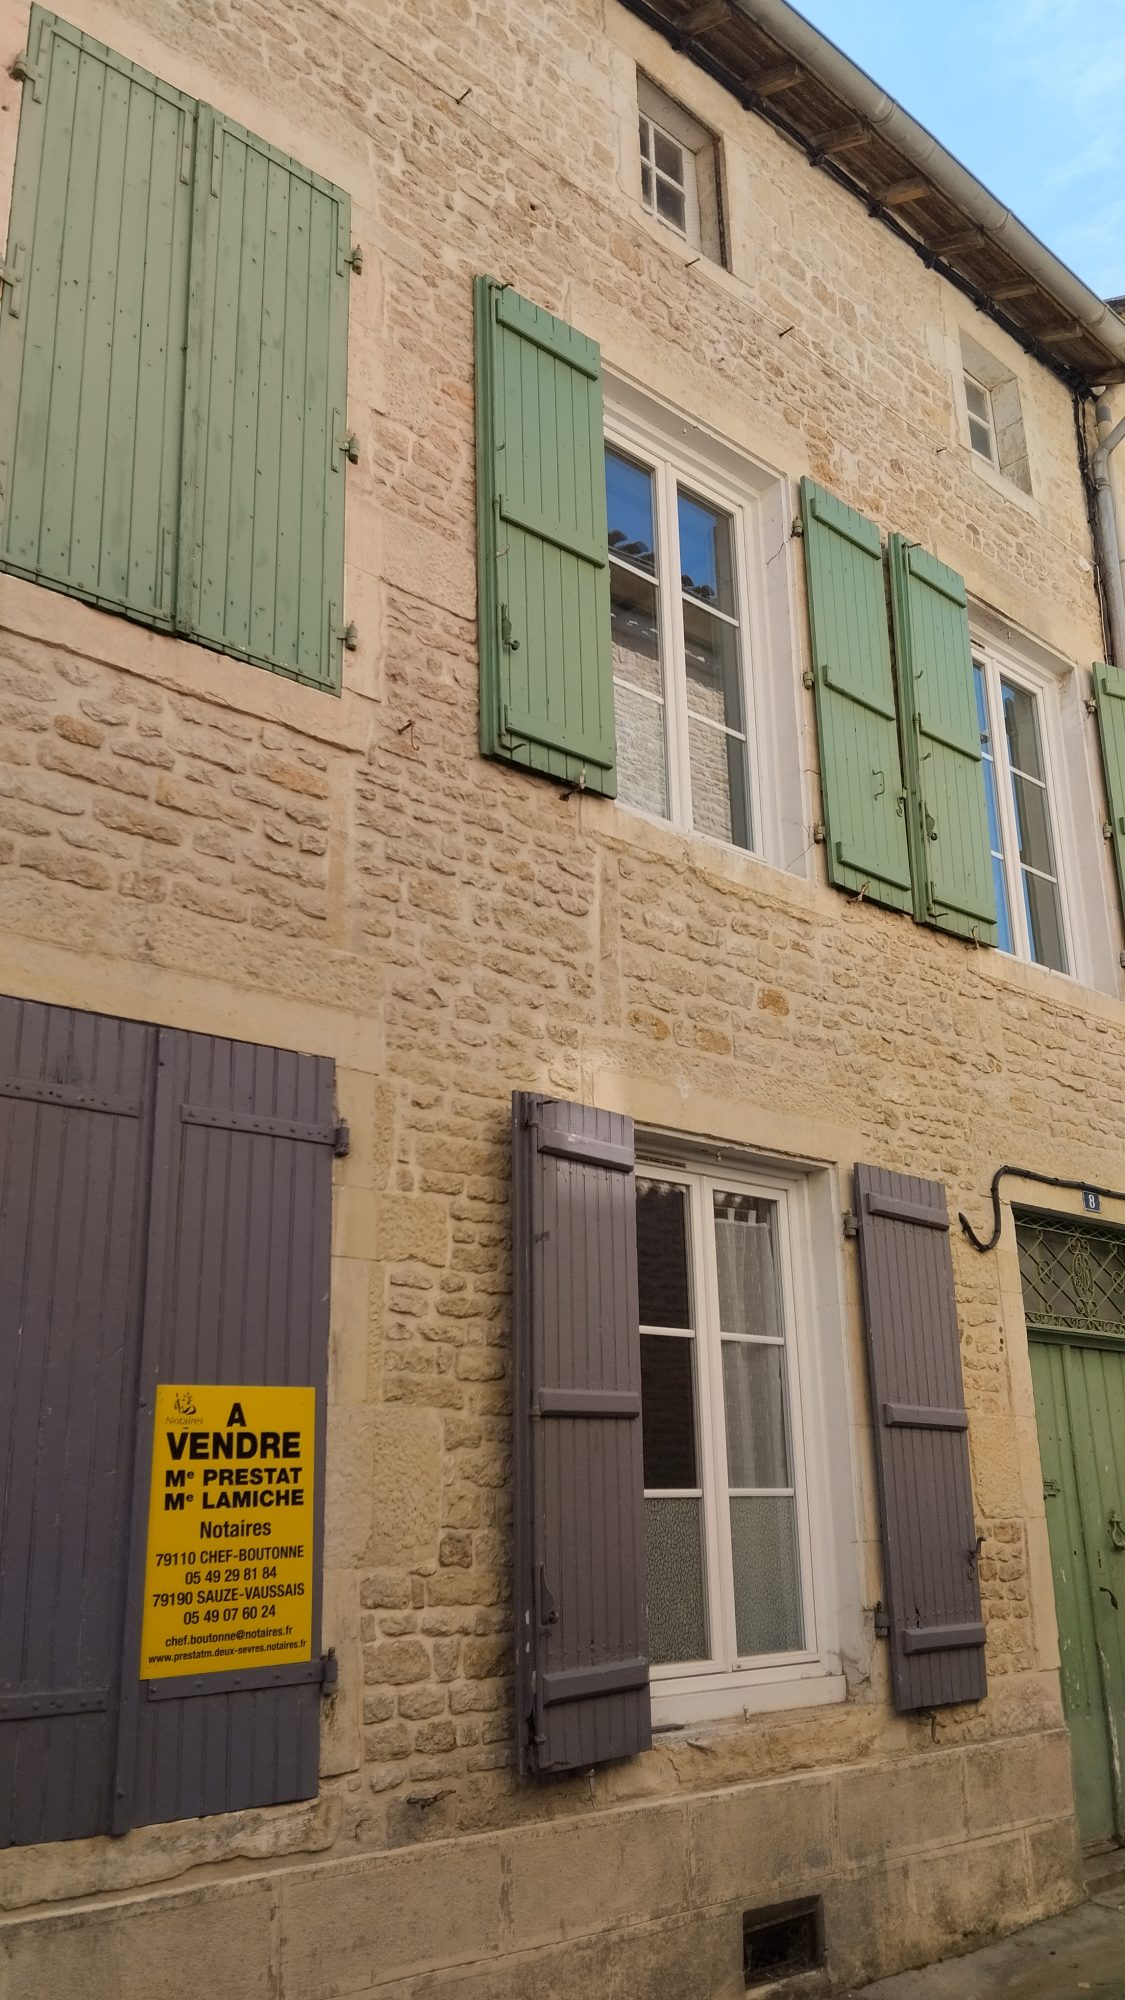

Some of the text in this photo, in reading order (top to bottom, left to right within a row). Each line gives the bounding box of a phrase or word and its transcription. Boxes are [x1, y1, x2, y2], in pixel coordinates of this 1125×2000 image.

[1089, 1194, 1096, 1208] 8
[165, 1416, 203, 1425] Notaires
[226, 1402, 246, 1427] A
[167, 1432, 300, 1460] VENDRE
[165, 1467, 302, 1487] Me PRESTAT
[164, 1489, 304, 1511] Me LAMICHE
[200, 1520, 271, 1539] Notaires
[156, 1545, 304, 1567] 79110 CHEF-BOUTONNE
[185, 1566, 277, 1585] 05 49 29 81 84
[152, 1583, 304, 1607] 79190 SAUZE-VAUSSAIS
[184, 1605, 276, 1625] 05 49 07 60 24
[165, 1625, 293, 1647] chef.boutonne@notaires.fr
